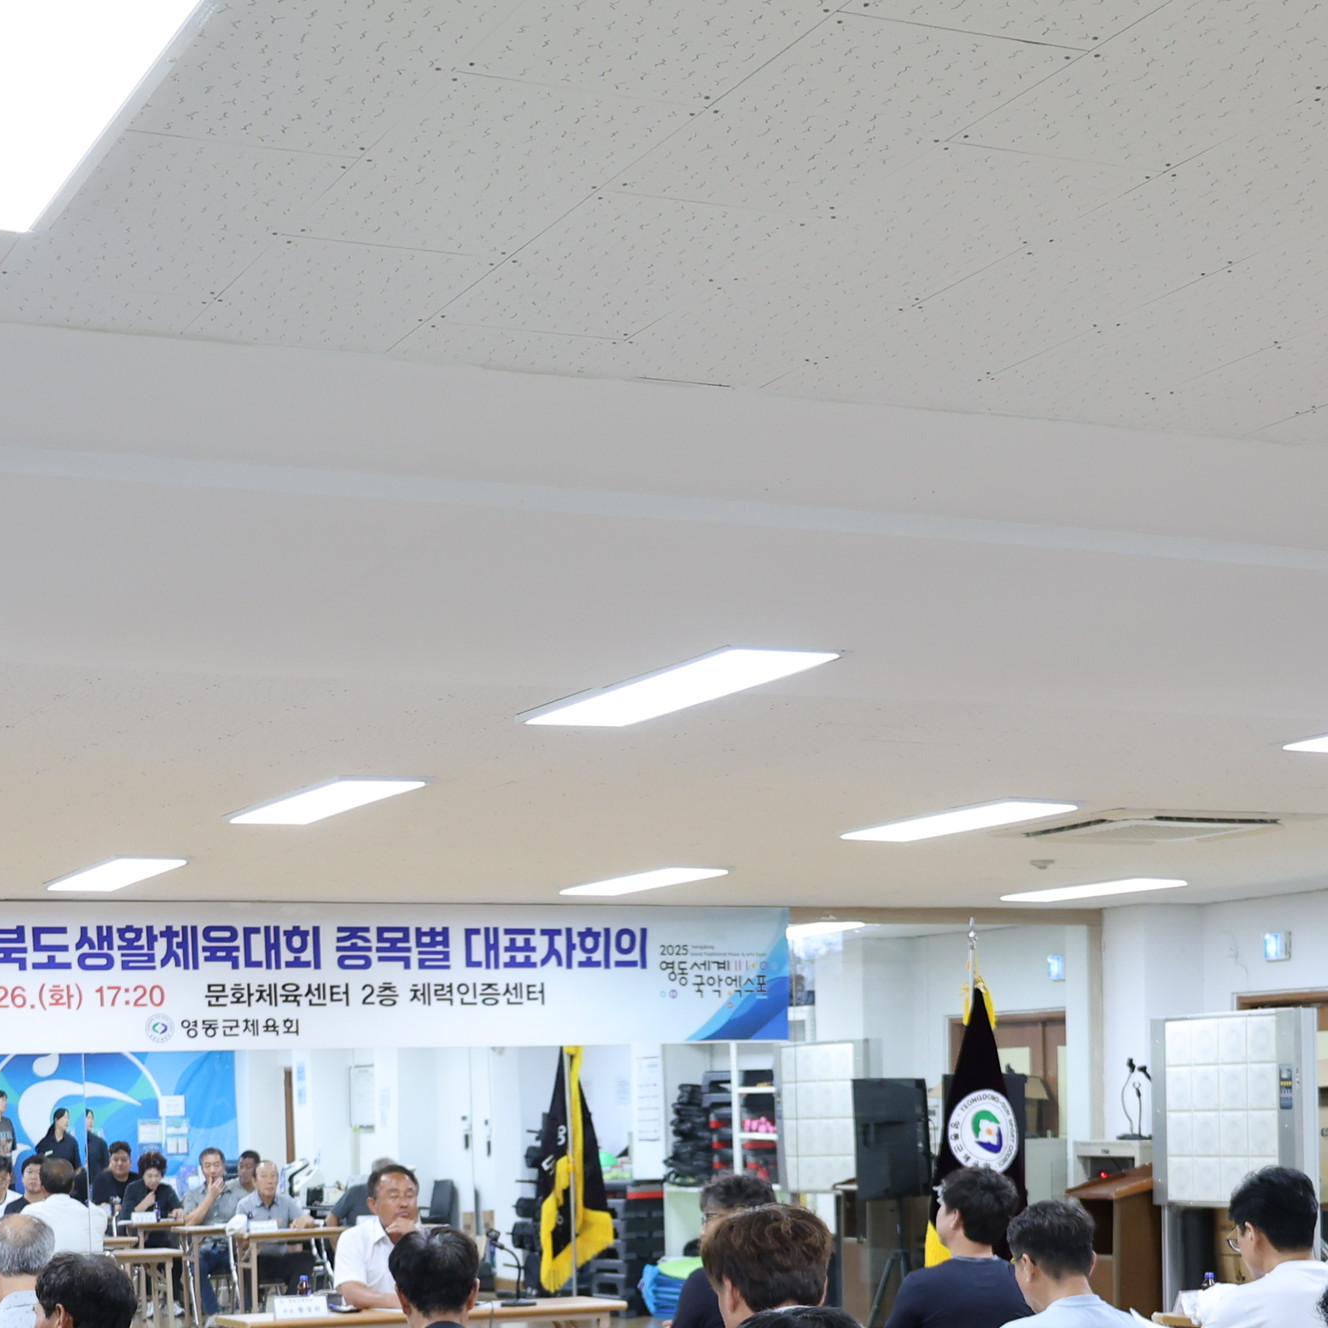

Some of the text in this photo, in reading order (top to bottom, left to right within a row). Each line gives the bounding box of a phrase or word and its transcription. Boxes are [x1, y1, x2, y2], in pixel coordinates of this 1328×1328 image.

[336, 925, 452, 970] 종목별
[464, 926, 648, 970] 대표자회의
[659, 944, 688, 956] 2025
[659, 960, 730, 987] 영동세계
[95, 985, 166, 1008] 17:20
[204, 983, 350, 1008] 문화체육센터
[361, 982, 400, 1007] 2층
[409, 982, 546, 1006] 체력인증센터
[692, 974, 768, 999] 국악엑스포
[180, 1018, 300, 1039] 영동군체육회
